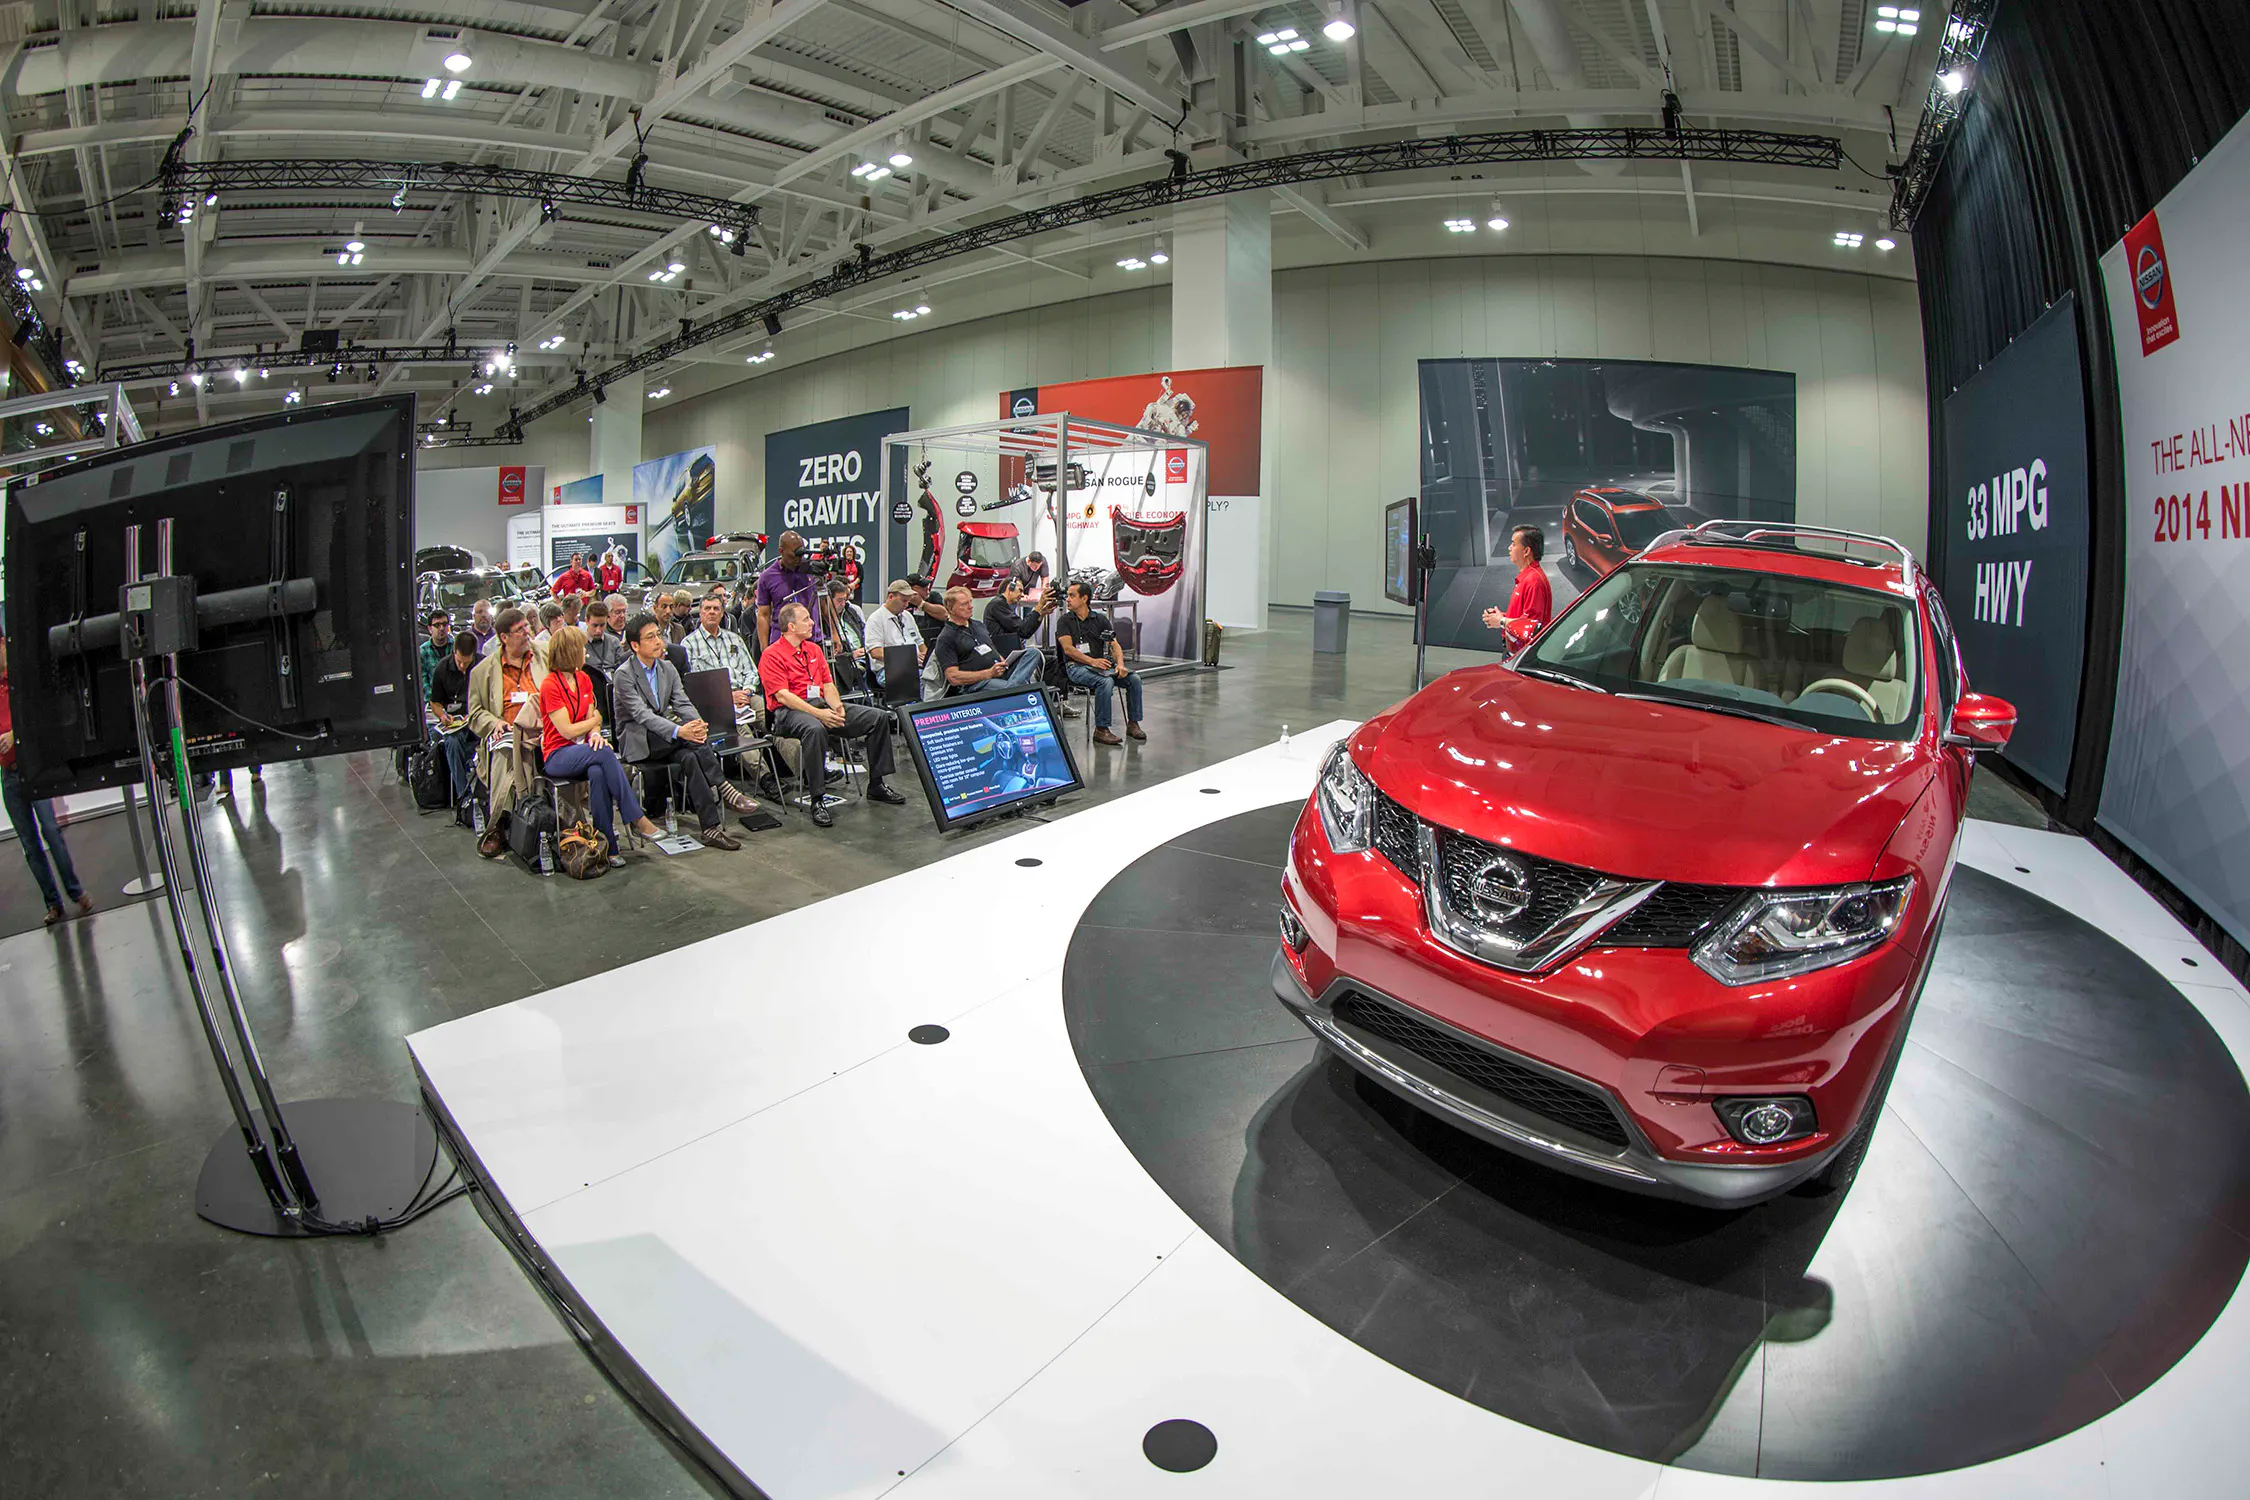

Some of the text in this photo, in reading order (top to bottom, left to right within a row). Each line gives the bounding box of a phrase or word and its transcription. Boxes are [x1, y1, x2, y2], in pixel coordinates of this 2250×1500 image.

[2139, 265, 2162, 287] NISSAN
[2146, 317, 2170, 335] Innovation
[2146, 324, 2172, 344] that excites
[799, 450, 862, 488] ZERO
[2151, 434, 2185, 475] THE
[1108, 476, 1144, 486] ROGUE
[784, 491, 881, 528] GRAVITY
[1967, 458, 2048, 541] 33 MPG
[2154, 490, 2212, 542] 2014
[1974, 560, 2032, 627] HWY
[914, 708, 982, 726] PREMIUM INTERIOR
[1473, 880, 1521, 903] NISSAN
